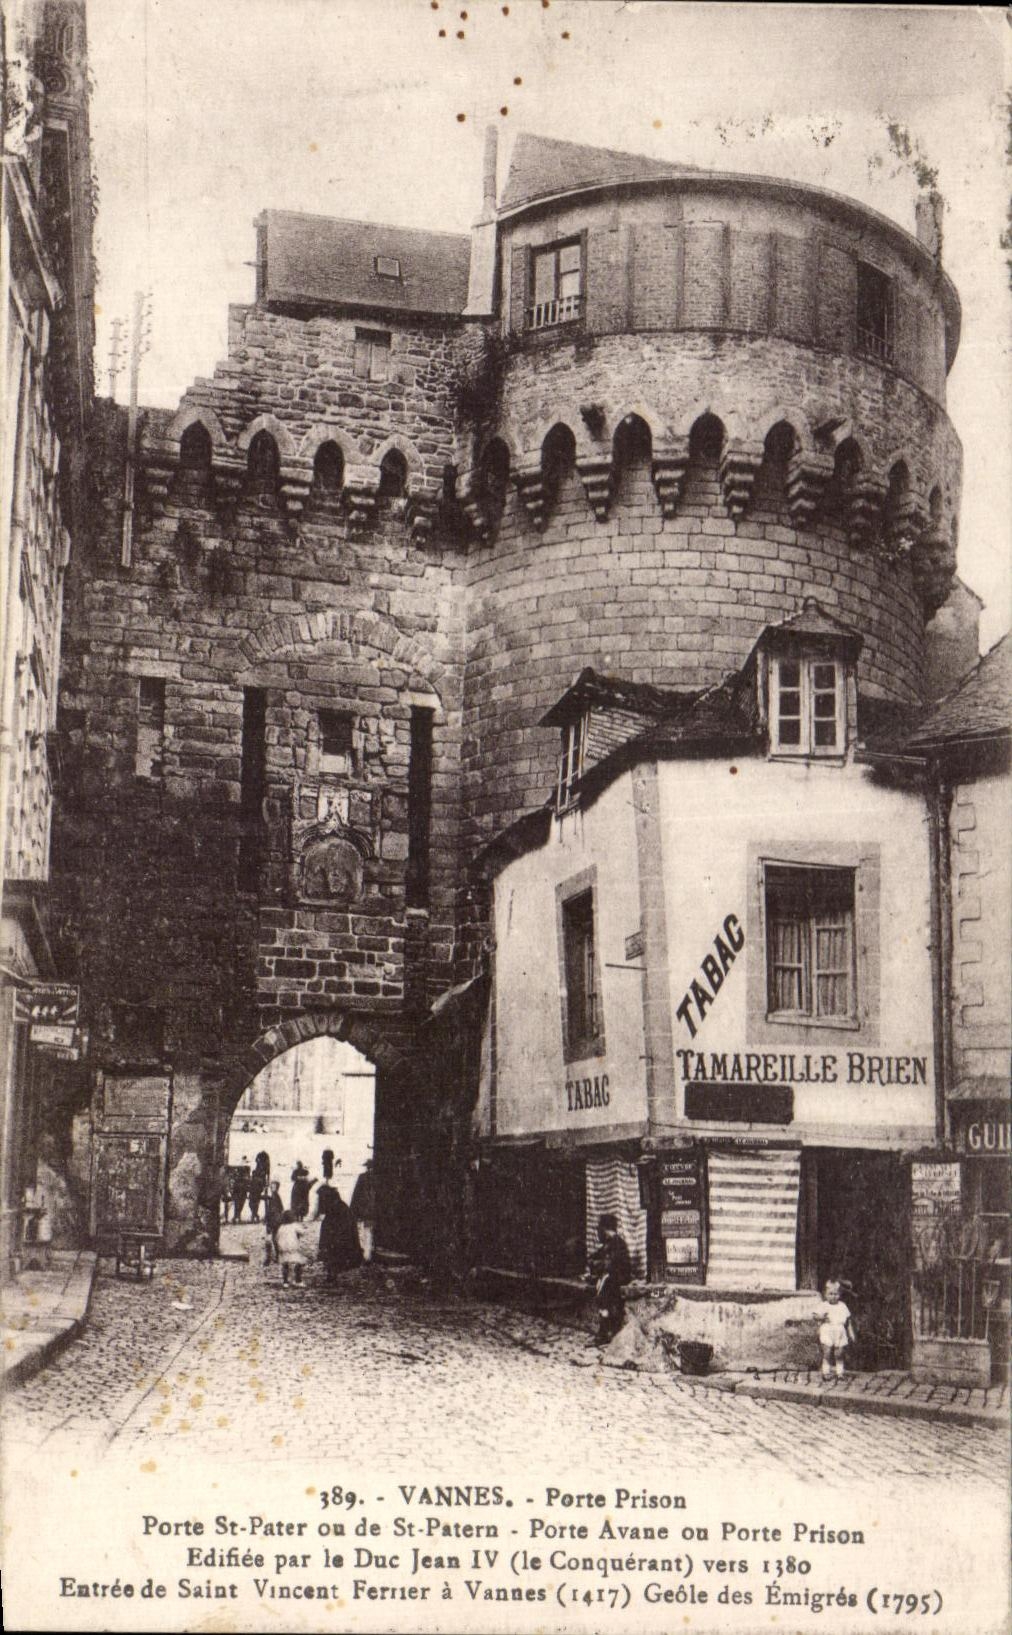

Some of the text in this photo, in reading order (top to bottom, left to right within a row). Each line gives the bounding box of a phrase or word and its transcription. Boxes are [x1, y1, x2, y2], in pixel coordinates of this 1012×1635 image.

[676, 914, 745, 1039] TABAC
[676, 1049, 928, 1086] TAMAREILLE BRIEN
[565, 1074, 610, 1112] TABAC
